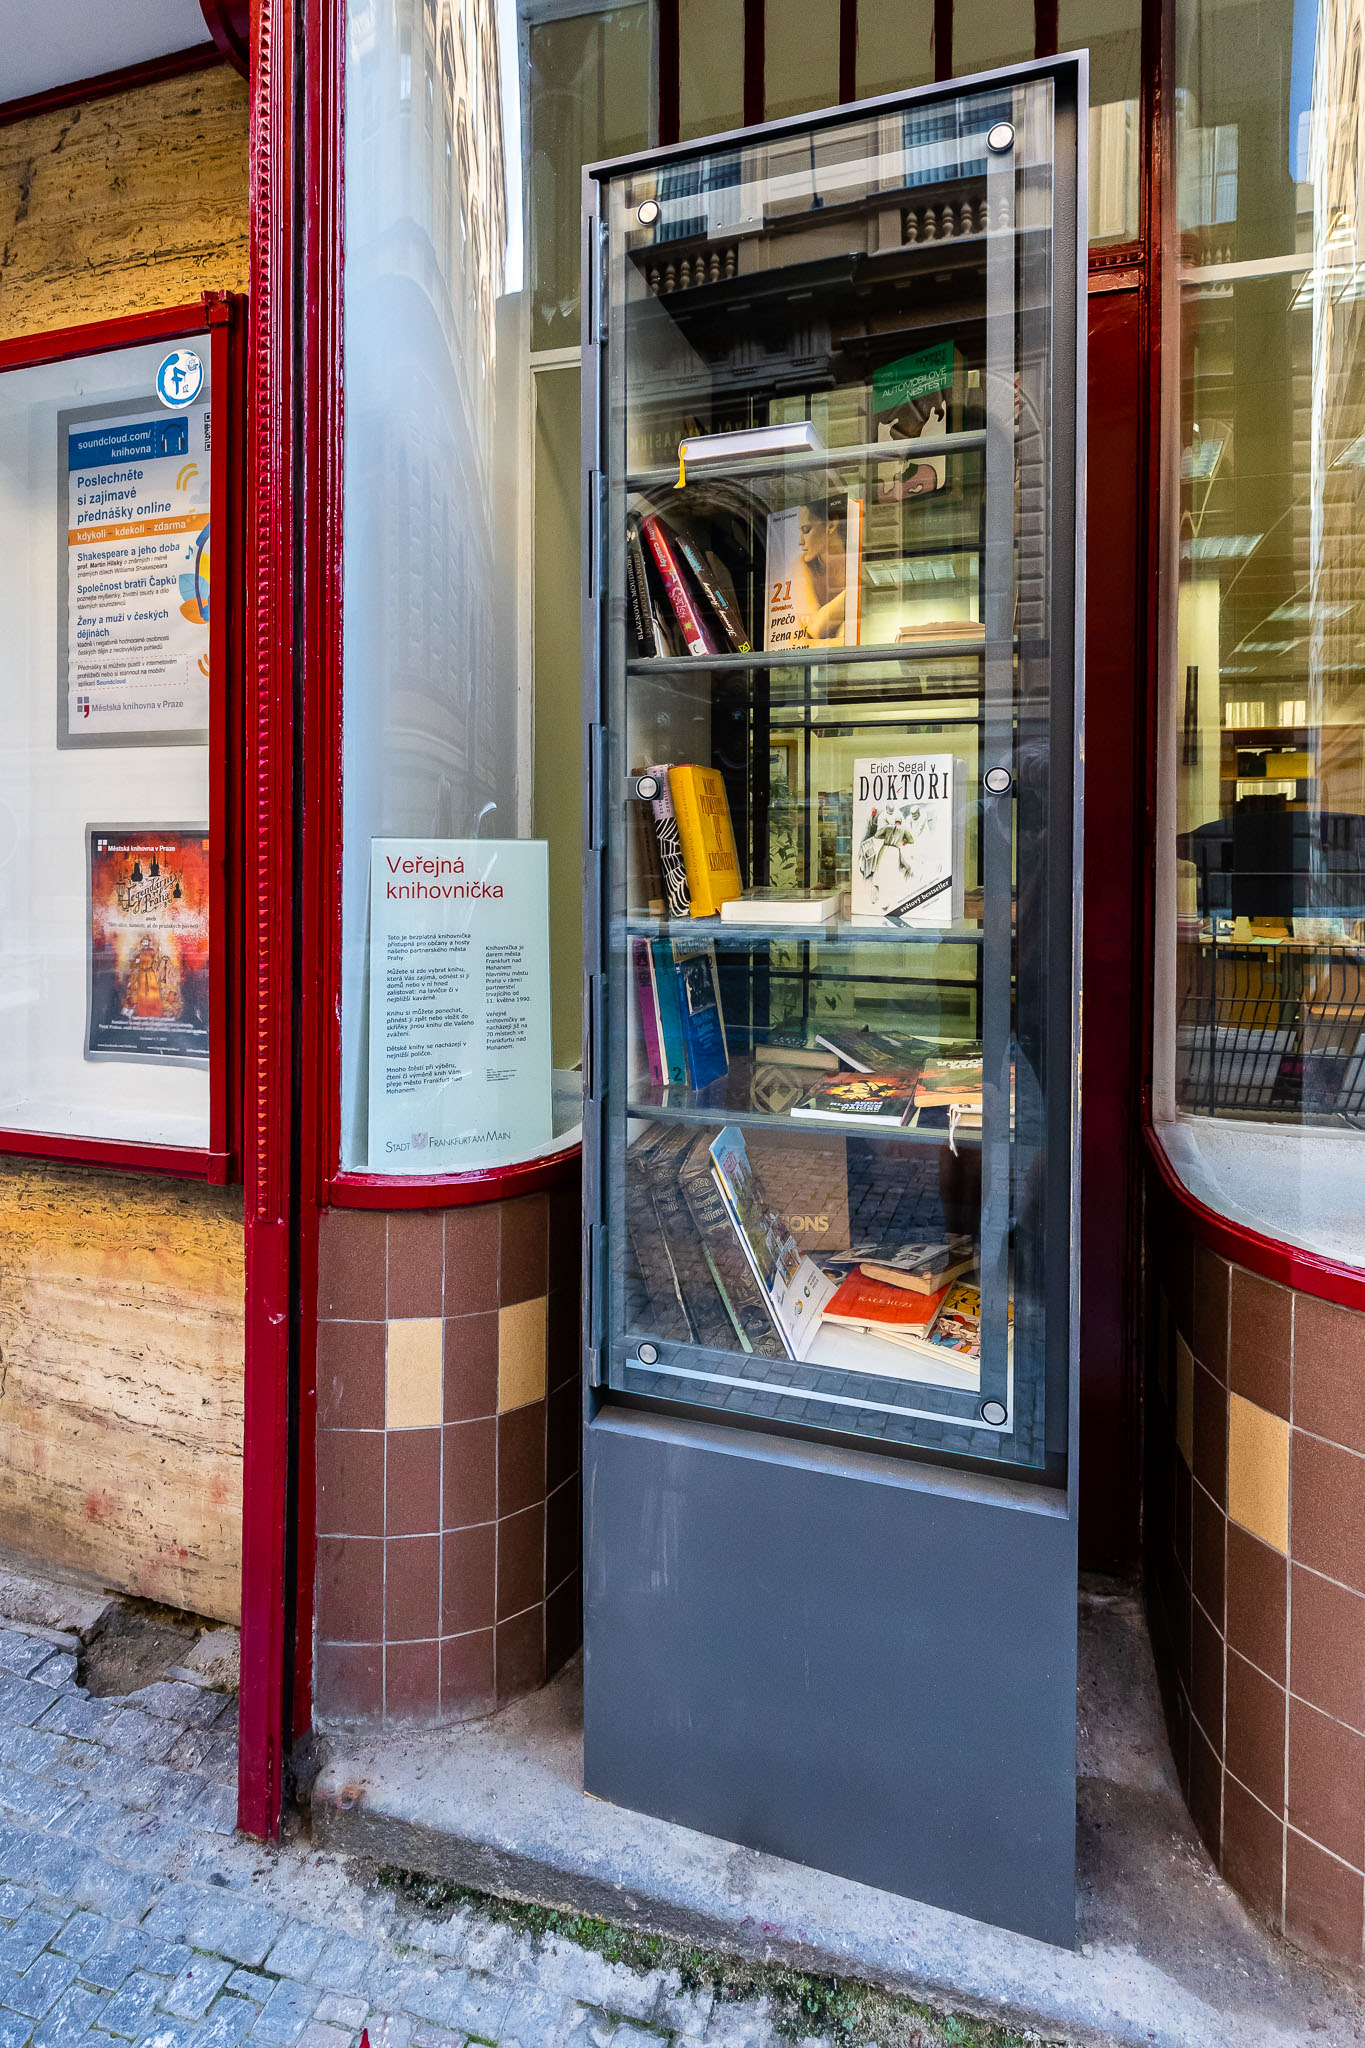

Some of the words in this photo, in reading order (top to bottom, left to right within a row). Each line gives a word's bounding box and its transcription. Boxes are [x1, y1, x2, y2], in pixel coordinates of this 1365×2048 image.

[78, 430, 151, 449] soundcloud.com/
[111, 445, 151, 457] knihovna
[77, 469, 143, 488] Poslechněte
[77, 494, 86, 505] si
[89, 486, 136, 505] zajímavé
[77, 506, 133, 525] přednášky
[136, 501, 171, 515] online
[77, 530, 106, 542] kdykoli
[115, 524, 145, 536] kdekoli
[153, 521, 186, 531] zdarma
[77, 549, 128, 561] Shakespeare
[138, 545, 157, 557] jeho
[160, 543, 180, 552] doba
[77, 582, 122, 595] Společnost
[124, 577, 147, 589] bratří
[149, 575, 177, 587] Čapků
[771, 580, 791, 603] 21
[77, 615, 96, 627] Ženy
[106, 613, 125, 623] muži
[134, 609, 169, 621] českých
[771, 613, 795, 629] prečo
[77, 628, 109, 640] dějinách
[771, 631, 791, 643] žena
[793, 626, 808, 640] spí
[91, 702, 121, 712] Městská
[122, 702, 155, 710] knihovna
[163, 700, 184, 708] Praze
[870, 763, 894, 774] Erich
[898, 761, 926, 775] Segal
[859, 764, 949, 801] DOKTOŘI
[386, 856, 465, 878] Veřejná
[386, 881, 504, 899] knihovnička
[672, 1067, 683, 1081] 2
